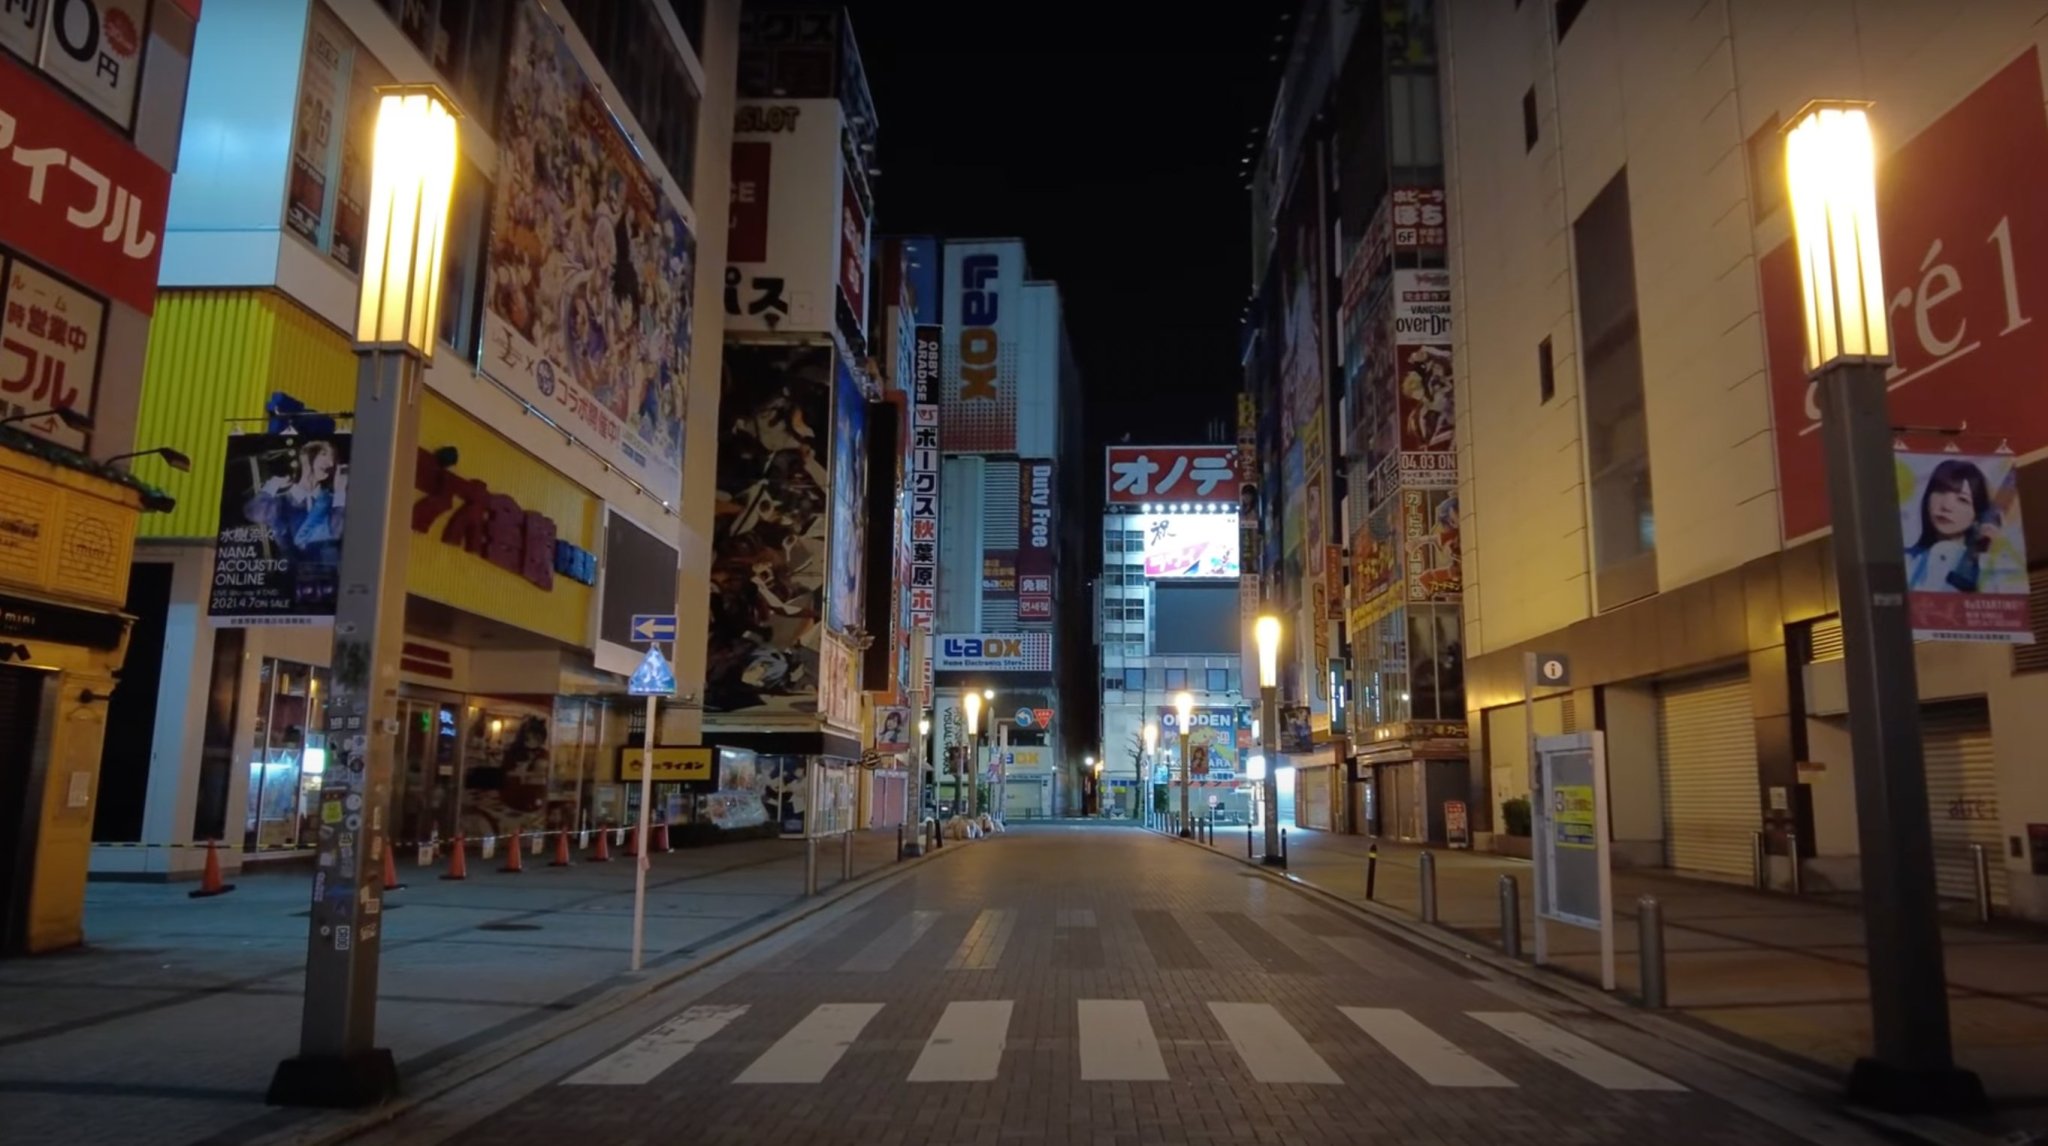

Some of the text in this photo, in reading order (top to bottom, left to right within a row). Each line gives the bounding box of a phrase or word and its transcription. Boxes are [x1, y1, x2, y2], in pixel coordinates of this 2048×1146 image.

[1398, 232, 1414, 242] 6F
[1112, 449, 1238, 495] オノデ
[1031, 465, 1051, 548] Duty Free
[218, 546, 257, 559] NANA
[216, 559, 289, 572] ACOUSTIC
[215, 572, 266, 586] ONLINE
